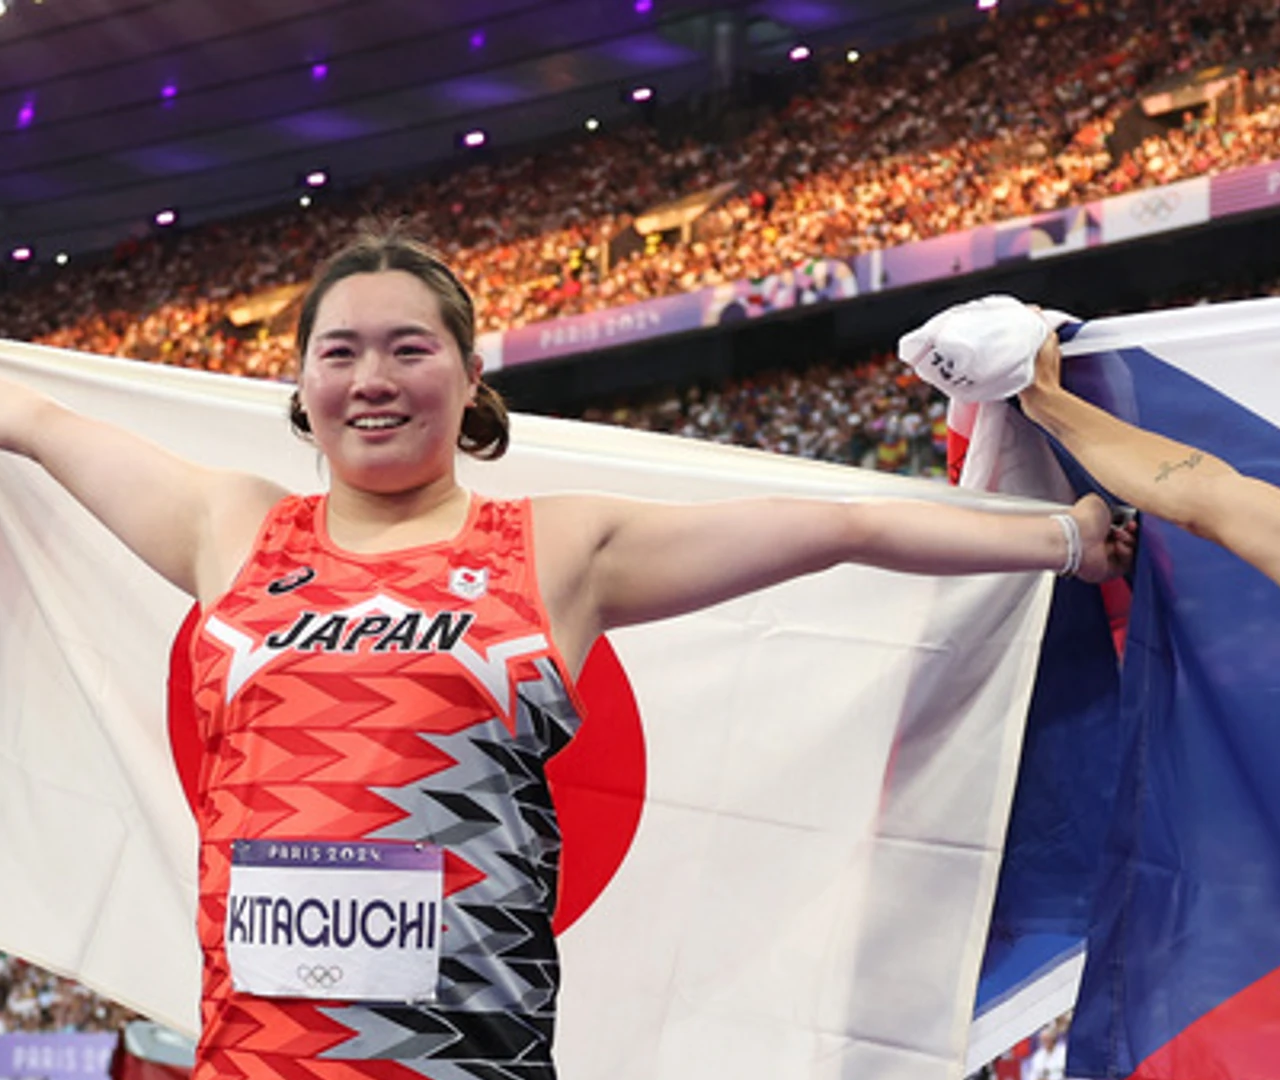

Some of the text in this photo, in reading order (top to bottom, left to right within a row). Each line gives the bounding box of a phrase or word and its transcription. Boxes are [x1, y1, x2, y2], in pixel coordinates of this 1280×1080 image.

[540, 320, 600, 349] PARIS
[266, 611, 474, 651] JAPAN
[268, 845, 382, 862] PARIS 2024
[229, 895, 436, 949] KITAGUCHI
